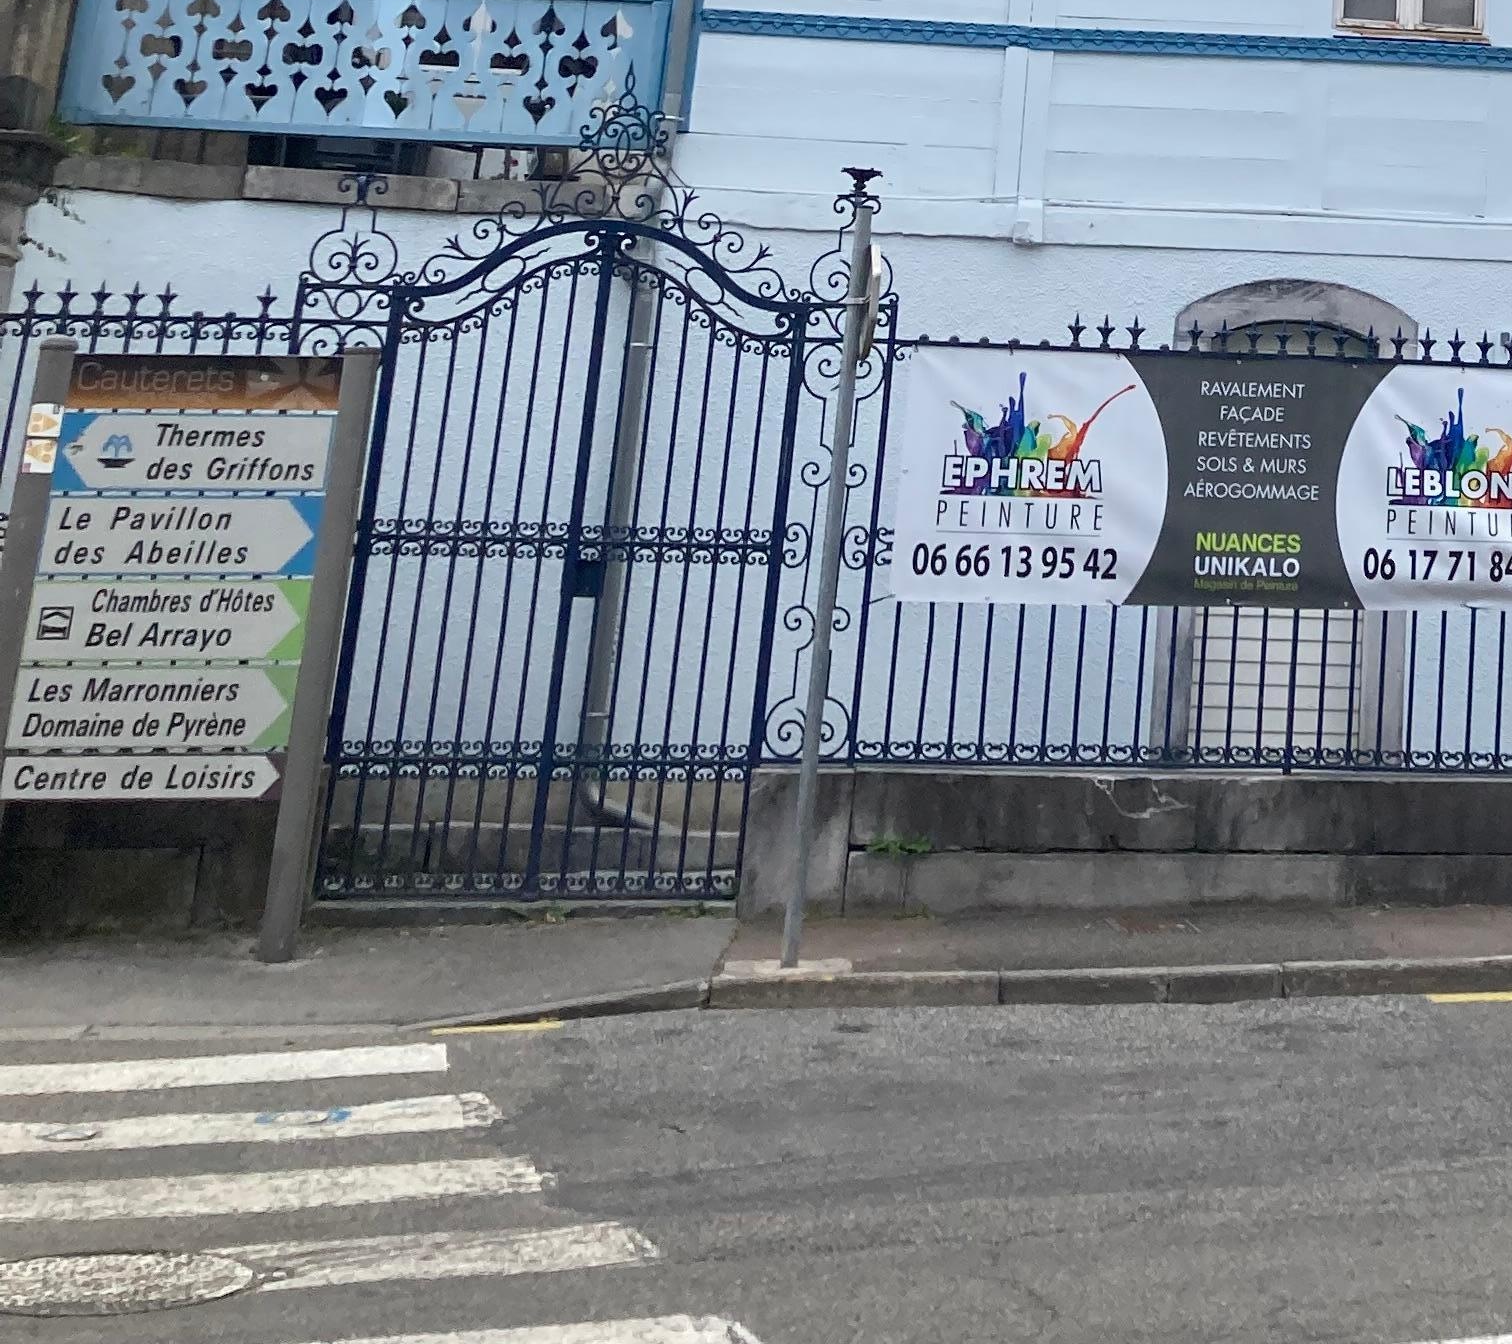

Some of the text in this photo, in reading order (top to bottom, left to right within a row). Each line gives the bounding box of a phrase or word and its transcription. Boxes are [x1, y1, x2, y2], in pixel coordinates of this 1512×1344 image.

[77, 362, 235, 392] Cauterets
[1200, 380, 1306, 399] RAVALEMENT
[1219, 405, 1285, 424] FAÇADE
[156, 423, 266, 448] Thermes
[1198, 429, 1312, 449] REVÊTEMENTS
[146, 457, 315, 481] des Griffons
[942, 455, 1103, 493] EPHREM
[1196, 455, 1307, 474] SOLS & MURS
[1183, 478, 1320, 501] AÉROGOMMAGE
[58, 506, 233, 531] Le Pavillon
[936, 500, 1104, 531] PEINTURE
[53, 540, 249, 565] des Abeilles
[1196, 532, 1301, 553] NUANCES
[912, 543, 1118, 580] 06 66 13 95 42
[1194, 555, 1300, 577] UNIKALO
[1363, 547, 1396, 581] 06
[1409, 550, 1439, 581] 17
[1448, 551, 1476, 581] 71
[91, 588, 275, 613] Chambres d'Hôtes
[84, 622, 232, 652] Bel Arrayo
[27, 677, 241, 703] Les Marronniers
[21, 712, 247, 743] Domaine de Pyrène
[14, 764, 256, 791] Centre de Loisirs
